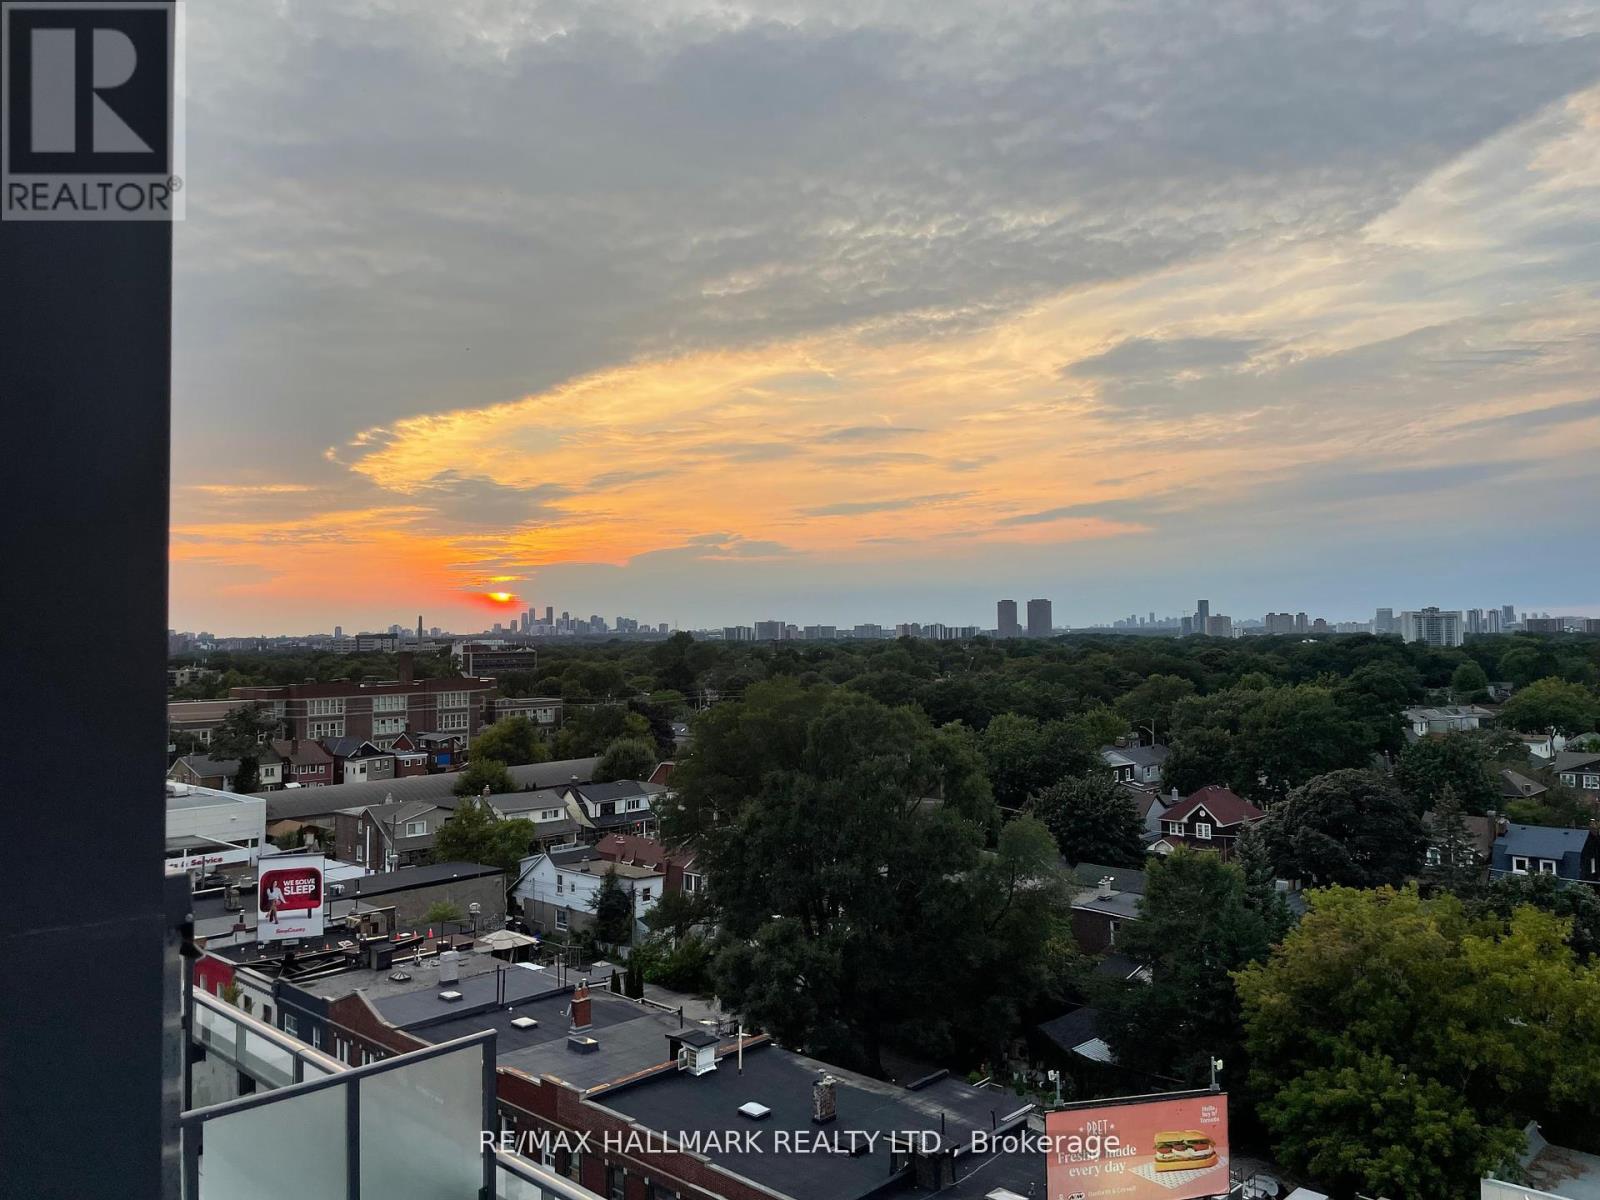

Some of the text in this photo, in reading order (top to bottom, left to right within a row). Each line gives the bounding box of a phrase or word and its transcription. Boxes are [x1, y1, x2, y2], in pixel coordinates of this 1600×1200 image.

[191, 857, 223, 866] Sevice
[284, 885, 315, 895] SLEEP
[1086, 1119, 1107, 1135] PRET
[1105, 1144, 1136, 1158] made
[1069, 1161, 1126, 1177] every day
